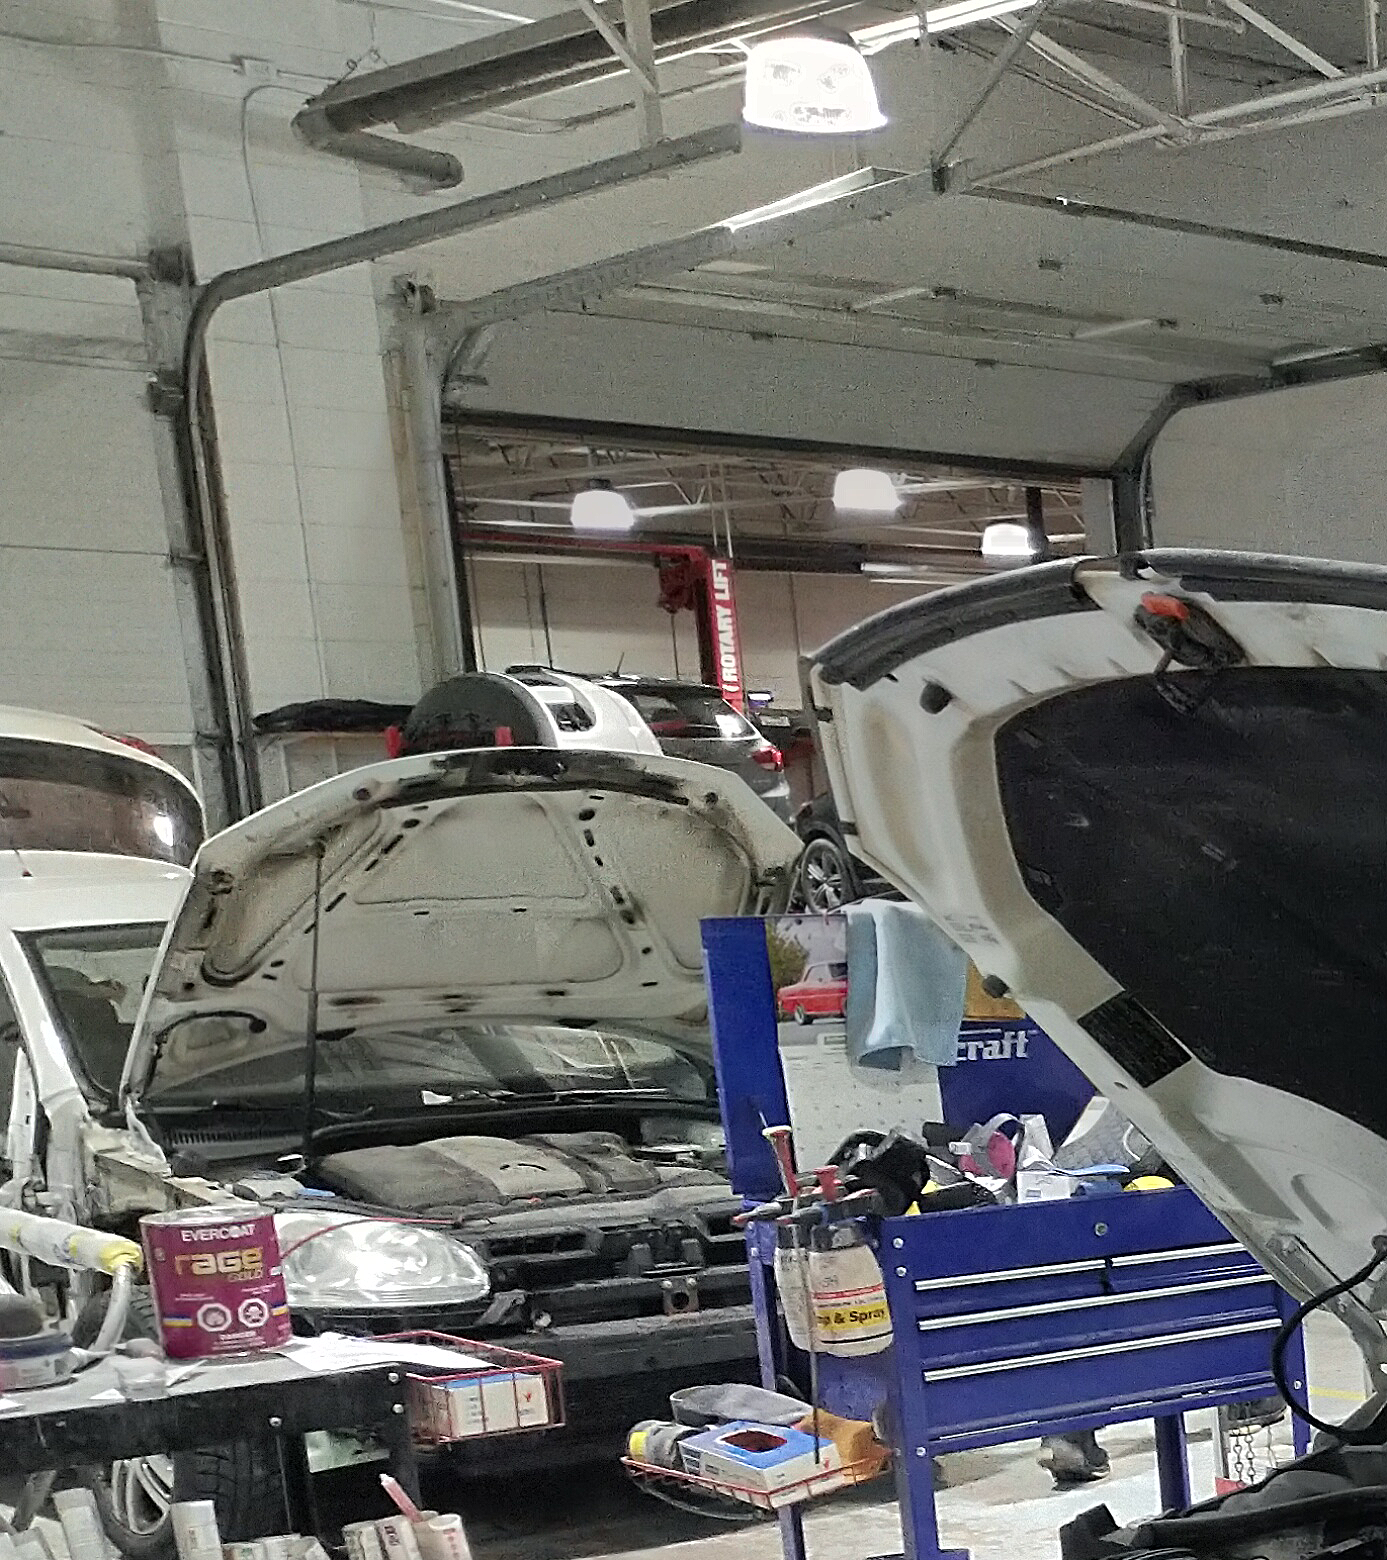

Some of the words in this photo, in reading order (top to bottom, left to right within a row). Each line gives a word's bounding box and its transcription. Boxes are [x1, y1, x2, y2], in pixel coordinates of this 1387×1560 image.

[711, 559, 731, 601] LIFT
[715, 604, 739, 682] ROTARY
[180, 1223, 256, 1242] EVERCOAT
